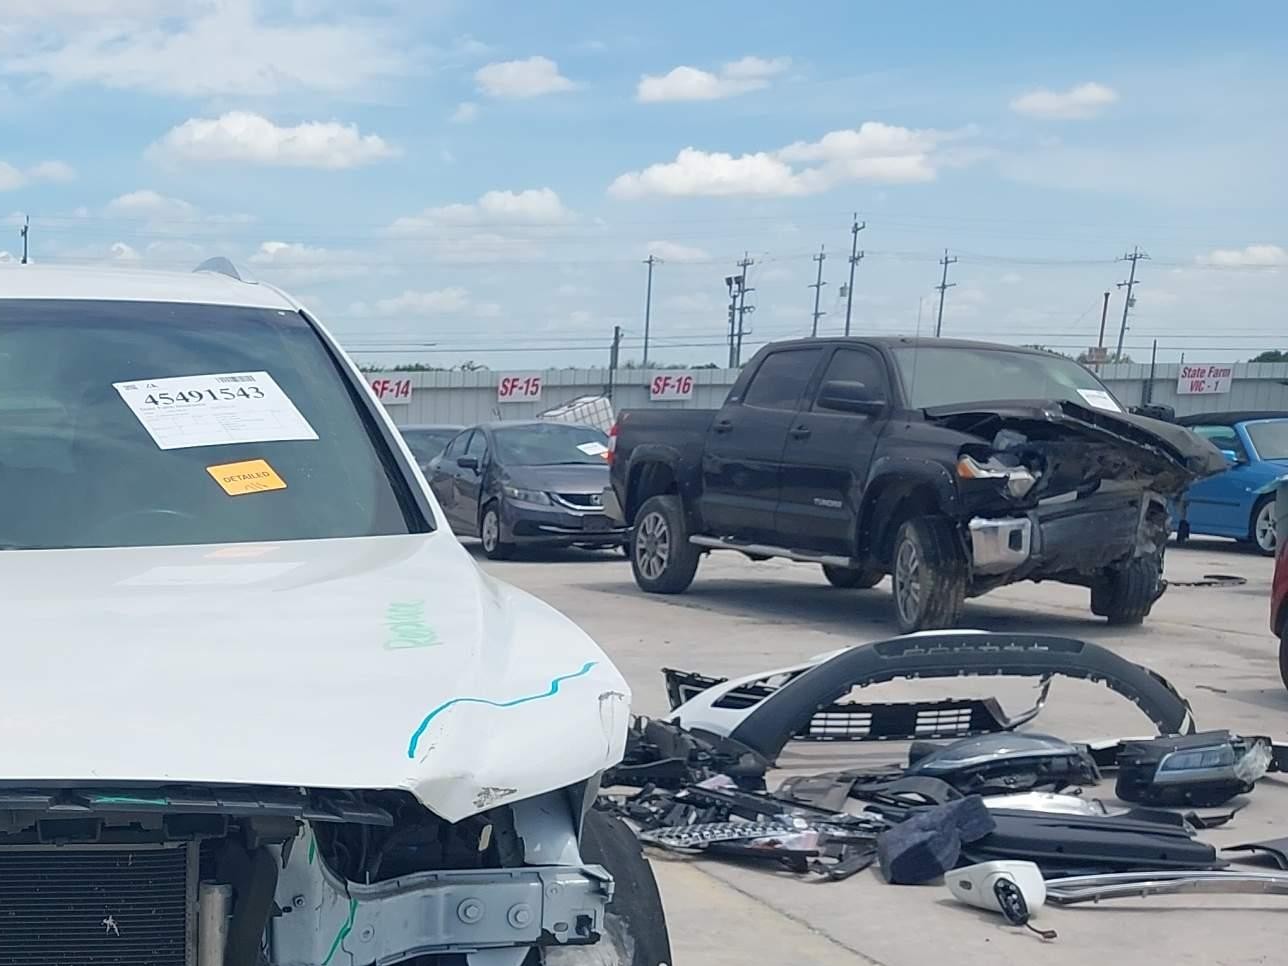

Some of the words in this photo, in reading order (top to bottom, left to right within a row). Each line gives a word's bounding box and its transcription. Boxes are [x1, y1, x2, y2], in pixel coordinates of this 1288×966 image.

[1181, 365, 1207, 379] State
[1207, 365, 1232, 378] Farm
[372, 380, 411, 399] SF-14
[499, 377, 541, 397] SF-15
[652, 375, 693, 395] SF-16
[1190, 380, 1205, 392] VIC
[144, 386, 265, 406] 45491543
[223, 471, 271, 484] DETAILED
